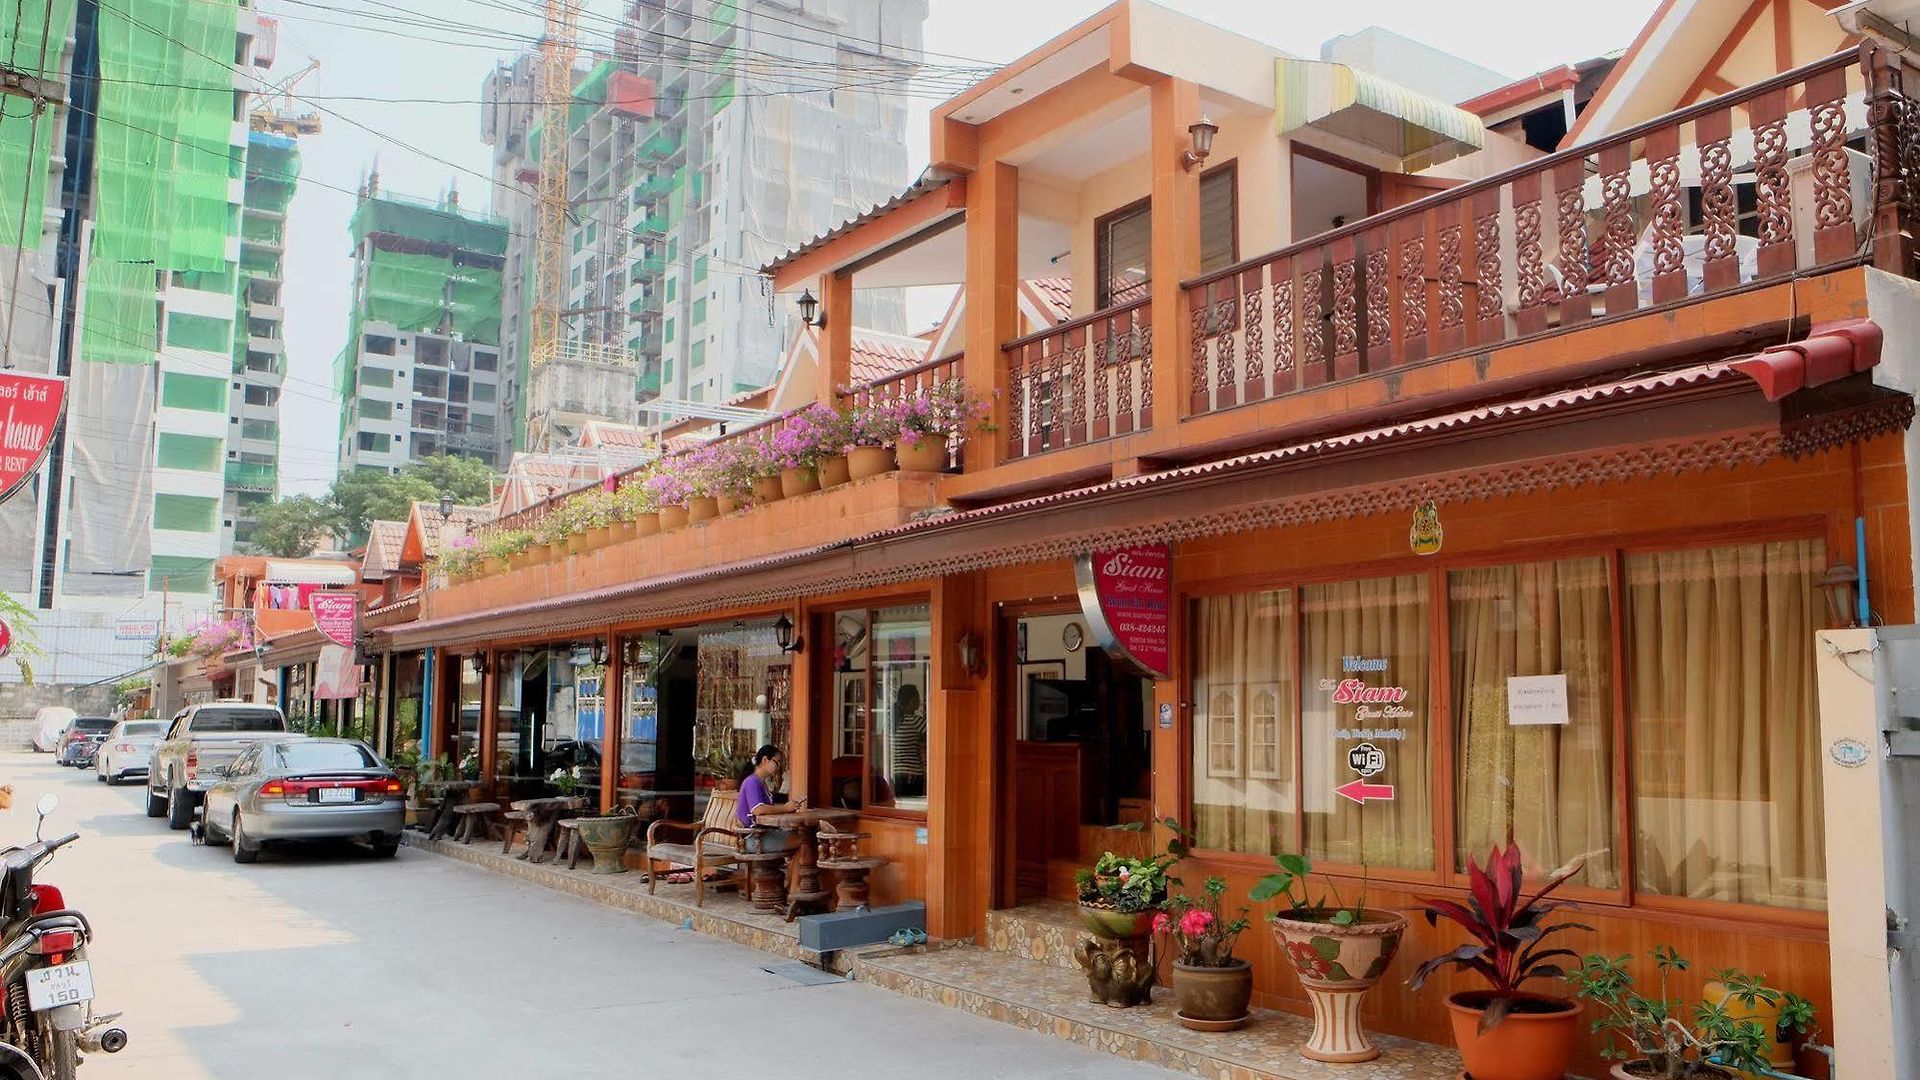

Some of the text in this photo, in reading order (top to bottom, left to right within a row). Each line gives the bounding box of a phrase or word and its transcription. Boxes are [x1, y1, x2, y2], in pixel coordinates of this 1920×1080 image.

[4, 403, 44, 452] house
[5, 455, 28, 473] RENT
[1103, 552, 1165, 580] Siam
[318, 599, 352, 610] Siam
[1343, 655, 1388, 672] Welcome
[1332, 679, 1408, 704] Siam
[47, 988, 80, 1004] 150
